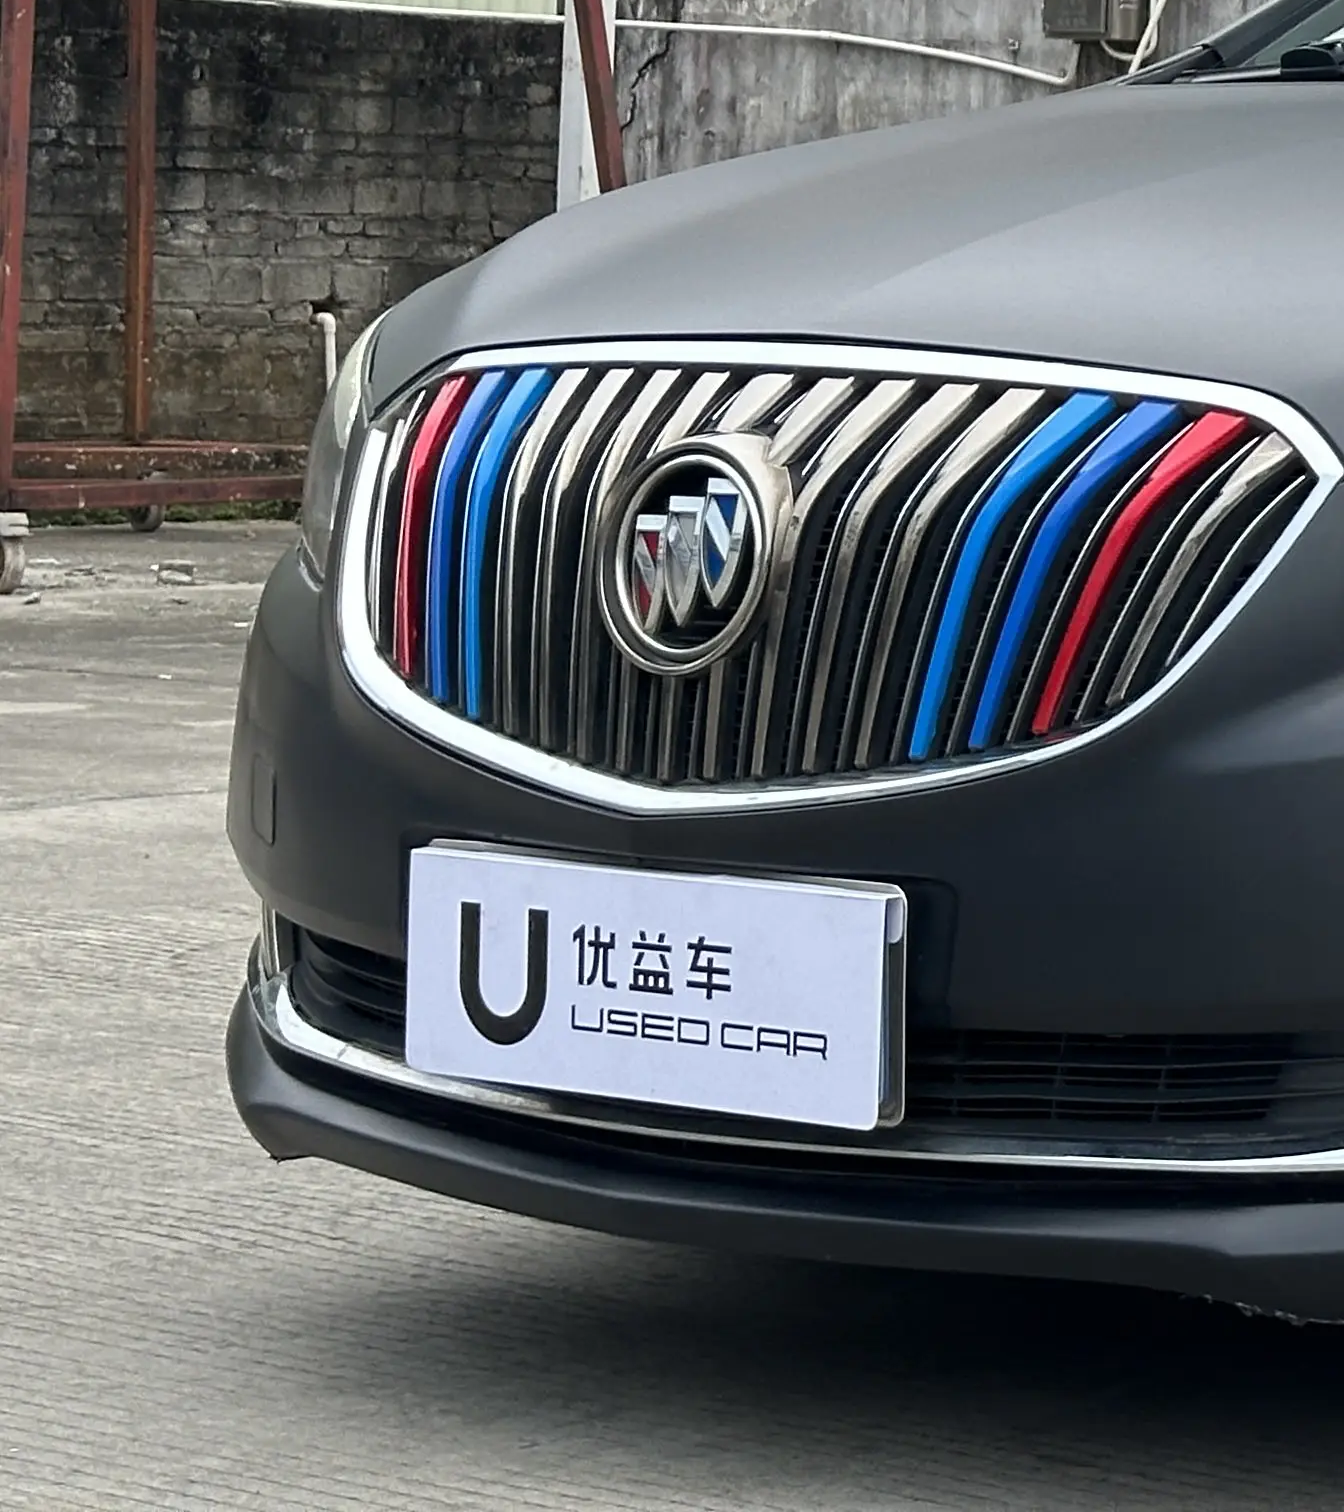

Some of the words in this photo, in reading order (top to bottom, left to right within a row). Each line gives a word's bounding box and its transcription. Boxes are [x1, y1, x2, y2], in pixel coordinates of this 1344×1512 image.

[459, 900, 550, 1046] U
[572, 923, 733, 1000] 优益车
[570, 1004, 710, 1046] USED
[720, 1022, 828, 1060] CAR
